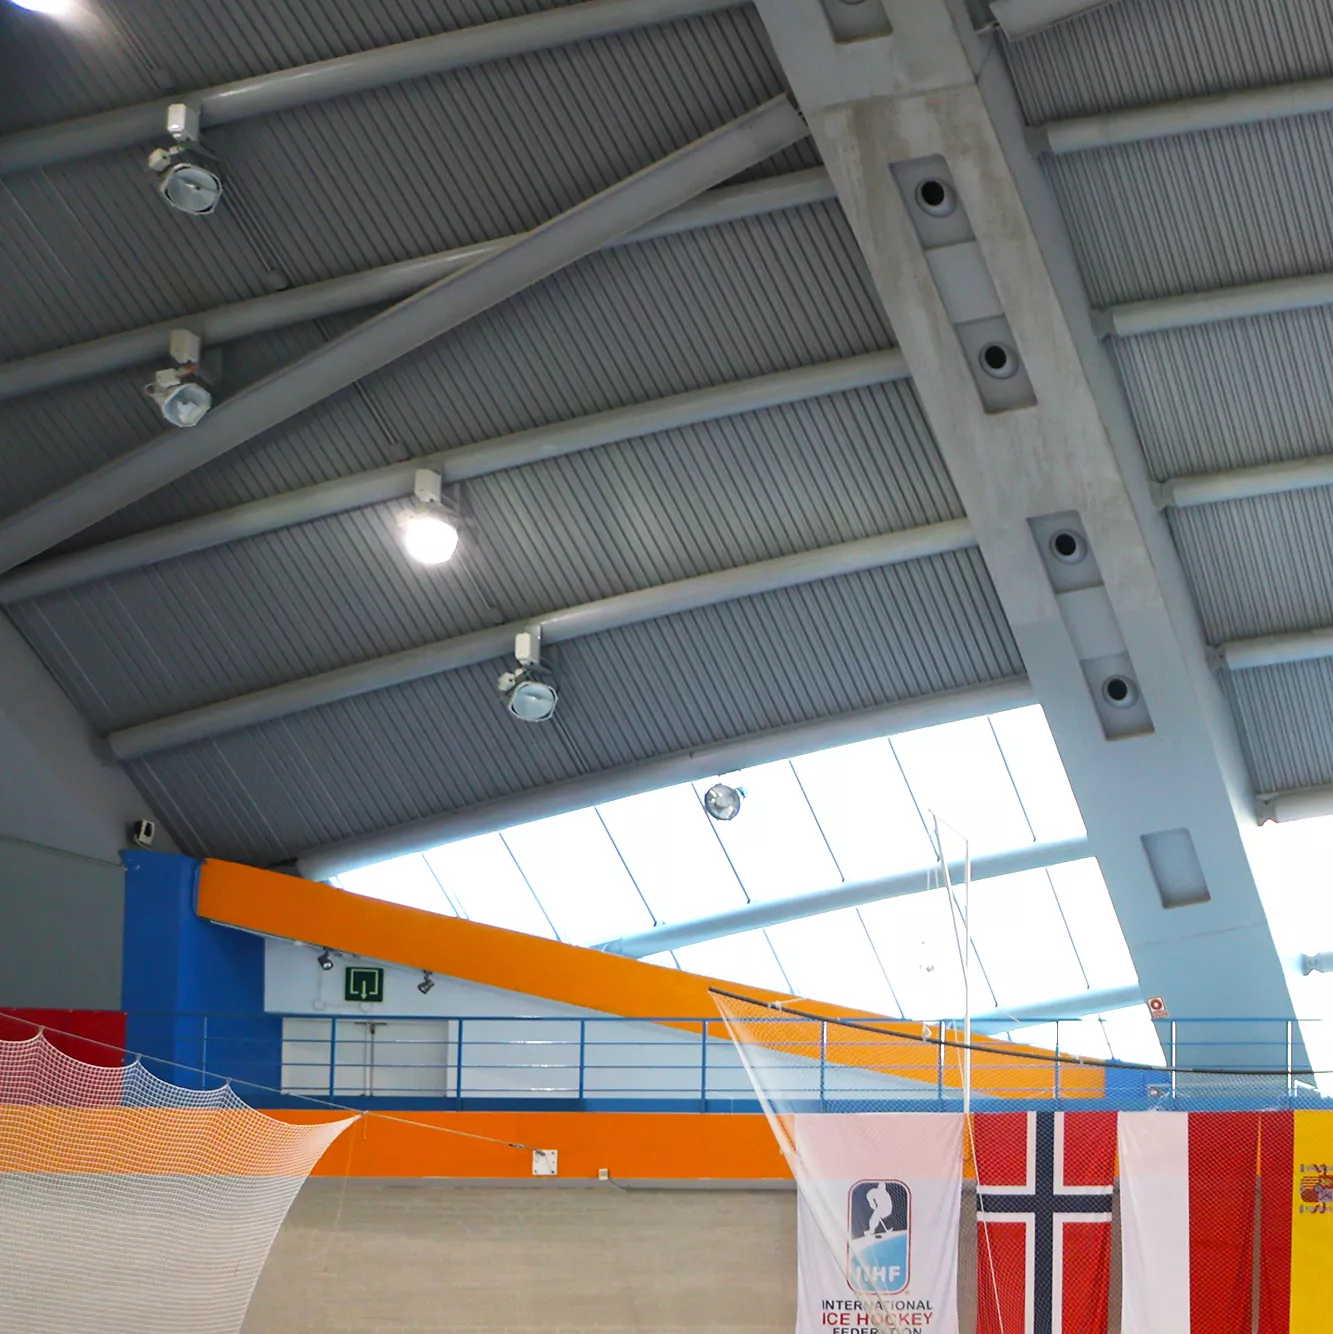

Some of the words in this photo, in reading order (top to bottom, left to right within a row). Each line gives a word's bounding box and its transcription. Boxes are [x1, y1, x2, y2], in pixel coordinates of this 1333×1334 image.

[822, 1299, 933, 1311] INTERAIONAL
[822, 1312, 851, 1326] ICE
[857, 1311, 933, 1326] HOCKEY
